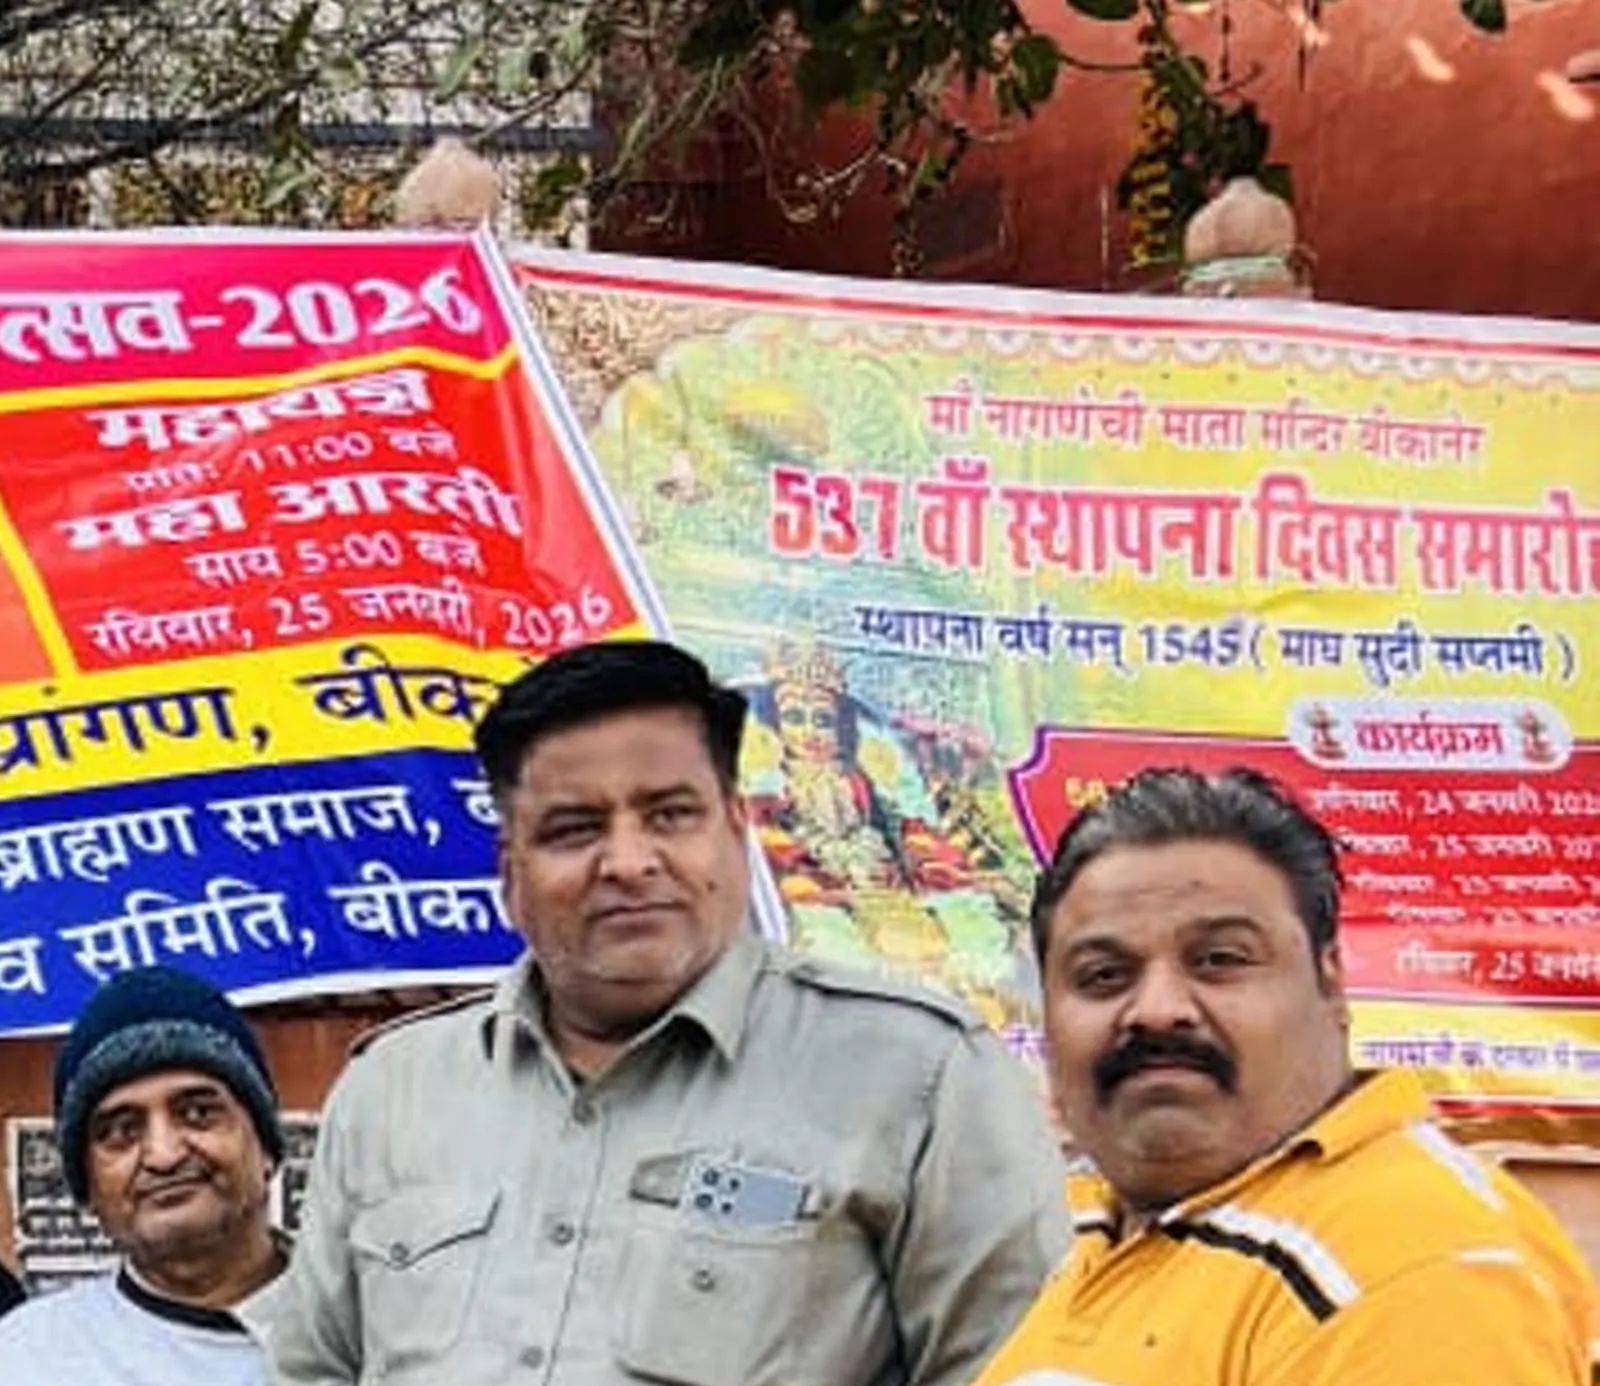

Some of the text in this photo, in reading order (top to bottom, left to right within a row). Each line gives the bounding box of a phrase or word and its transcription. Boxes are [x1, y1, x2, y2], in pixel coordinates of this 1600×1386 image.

[1161, 406, 1249, 448] माता
[51, 464, 526, 550] महा आरती
[771, 466, 898, 558] 537
[1001, 486, 1241, 578] स्थापना
[1251, 473, 1398, 584] दिवस
[297, 529, 403, 578] 5:00
[274, 594, 333, 638] 25
[503, 589, 613, 648] 2026
[854, 605, 984, 653] स्थापना
[997, 604, 1054, 657] वर्ष
[1277, 628, 1345, 666] माघ
[1354, 618, 1421, 687] सुदी
[1431, 623, 1543, 672] सप्तमी
[1356, 710, 1504, 759] कार्यक्रम
[205, 783, 441, 854] समाज,
[59, 877, 316, 984] समिति,
